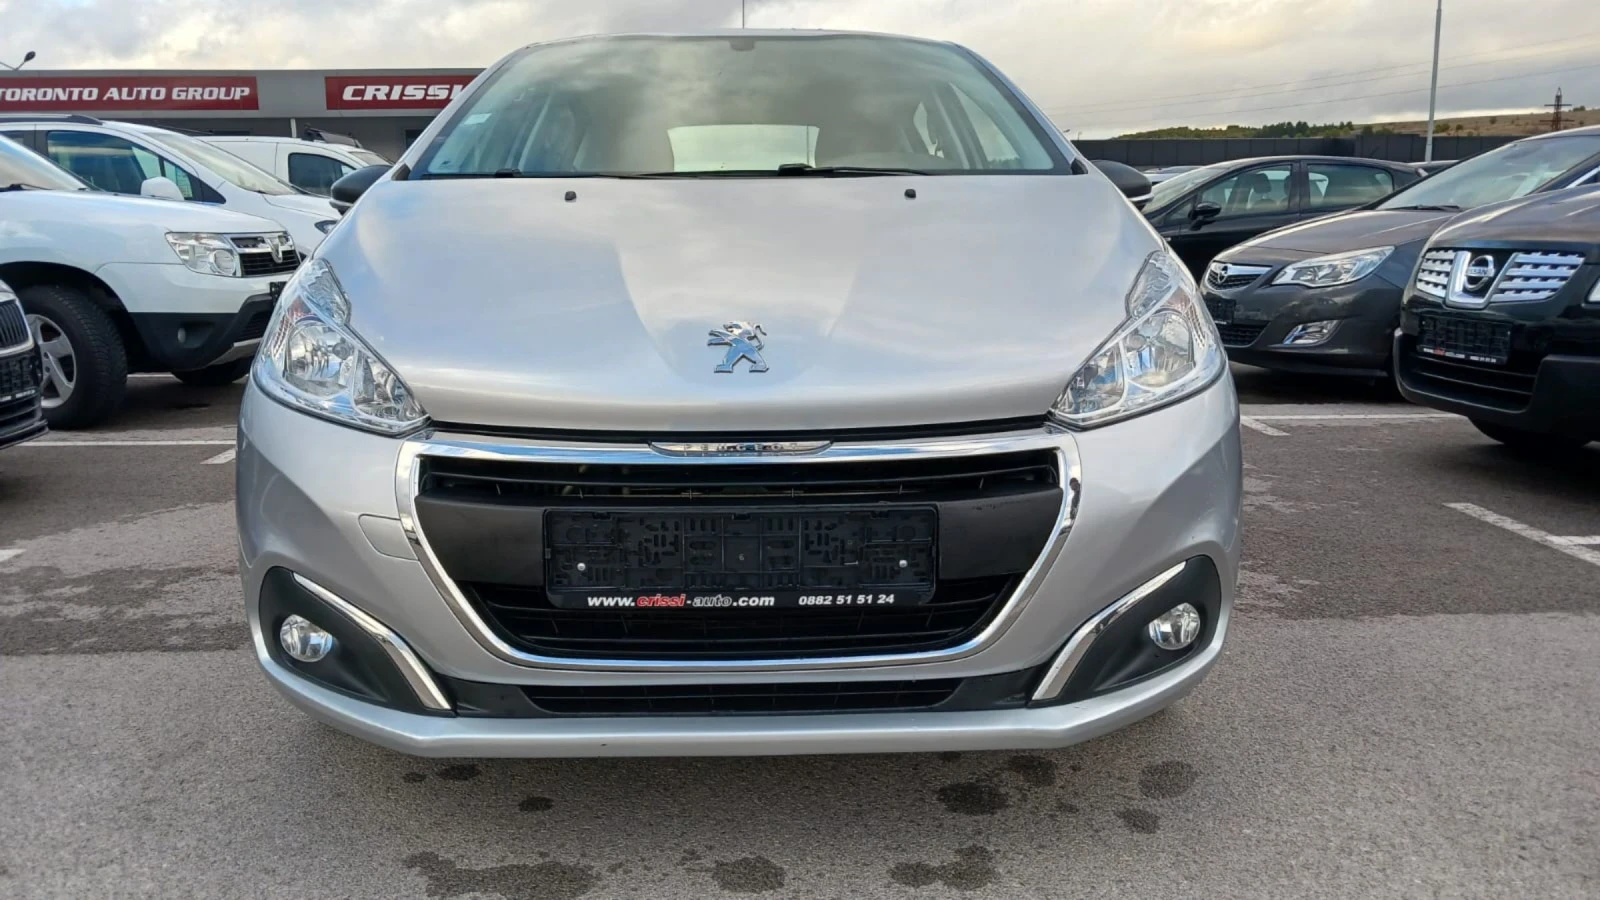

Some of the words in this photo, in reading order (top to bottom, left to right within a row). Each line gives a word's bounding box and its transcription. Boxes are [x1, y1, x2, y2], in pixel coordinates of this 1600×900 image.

[103, 87, 167, 100] AUTO
[171, 87, 250, 100] GROUP
[342, 84, 464, 100] CRISSI
[587, 594, 775, 607] www.crissi-auto.com
[798, 595, 833, 605] 0882
[836, 595, 852, 605] 51
[856, 594, 873, 604] 51
[877, 594, 895, 604] 24
